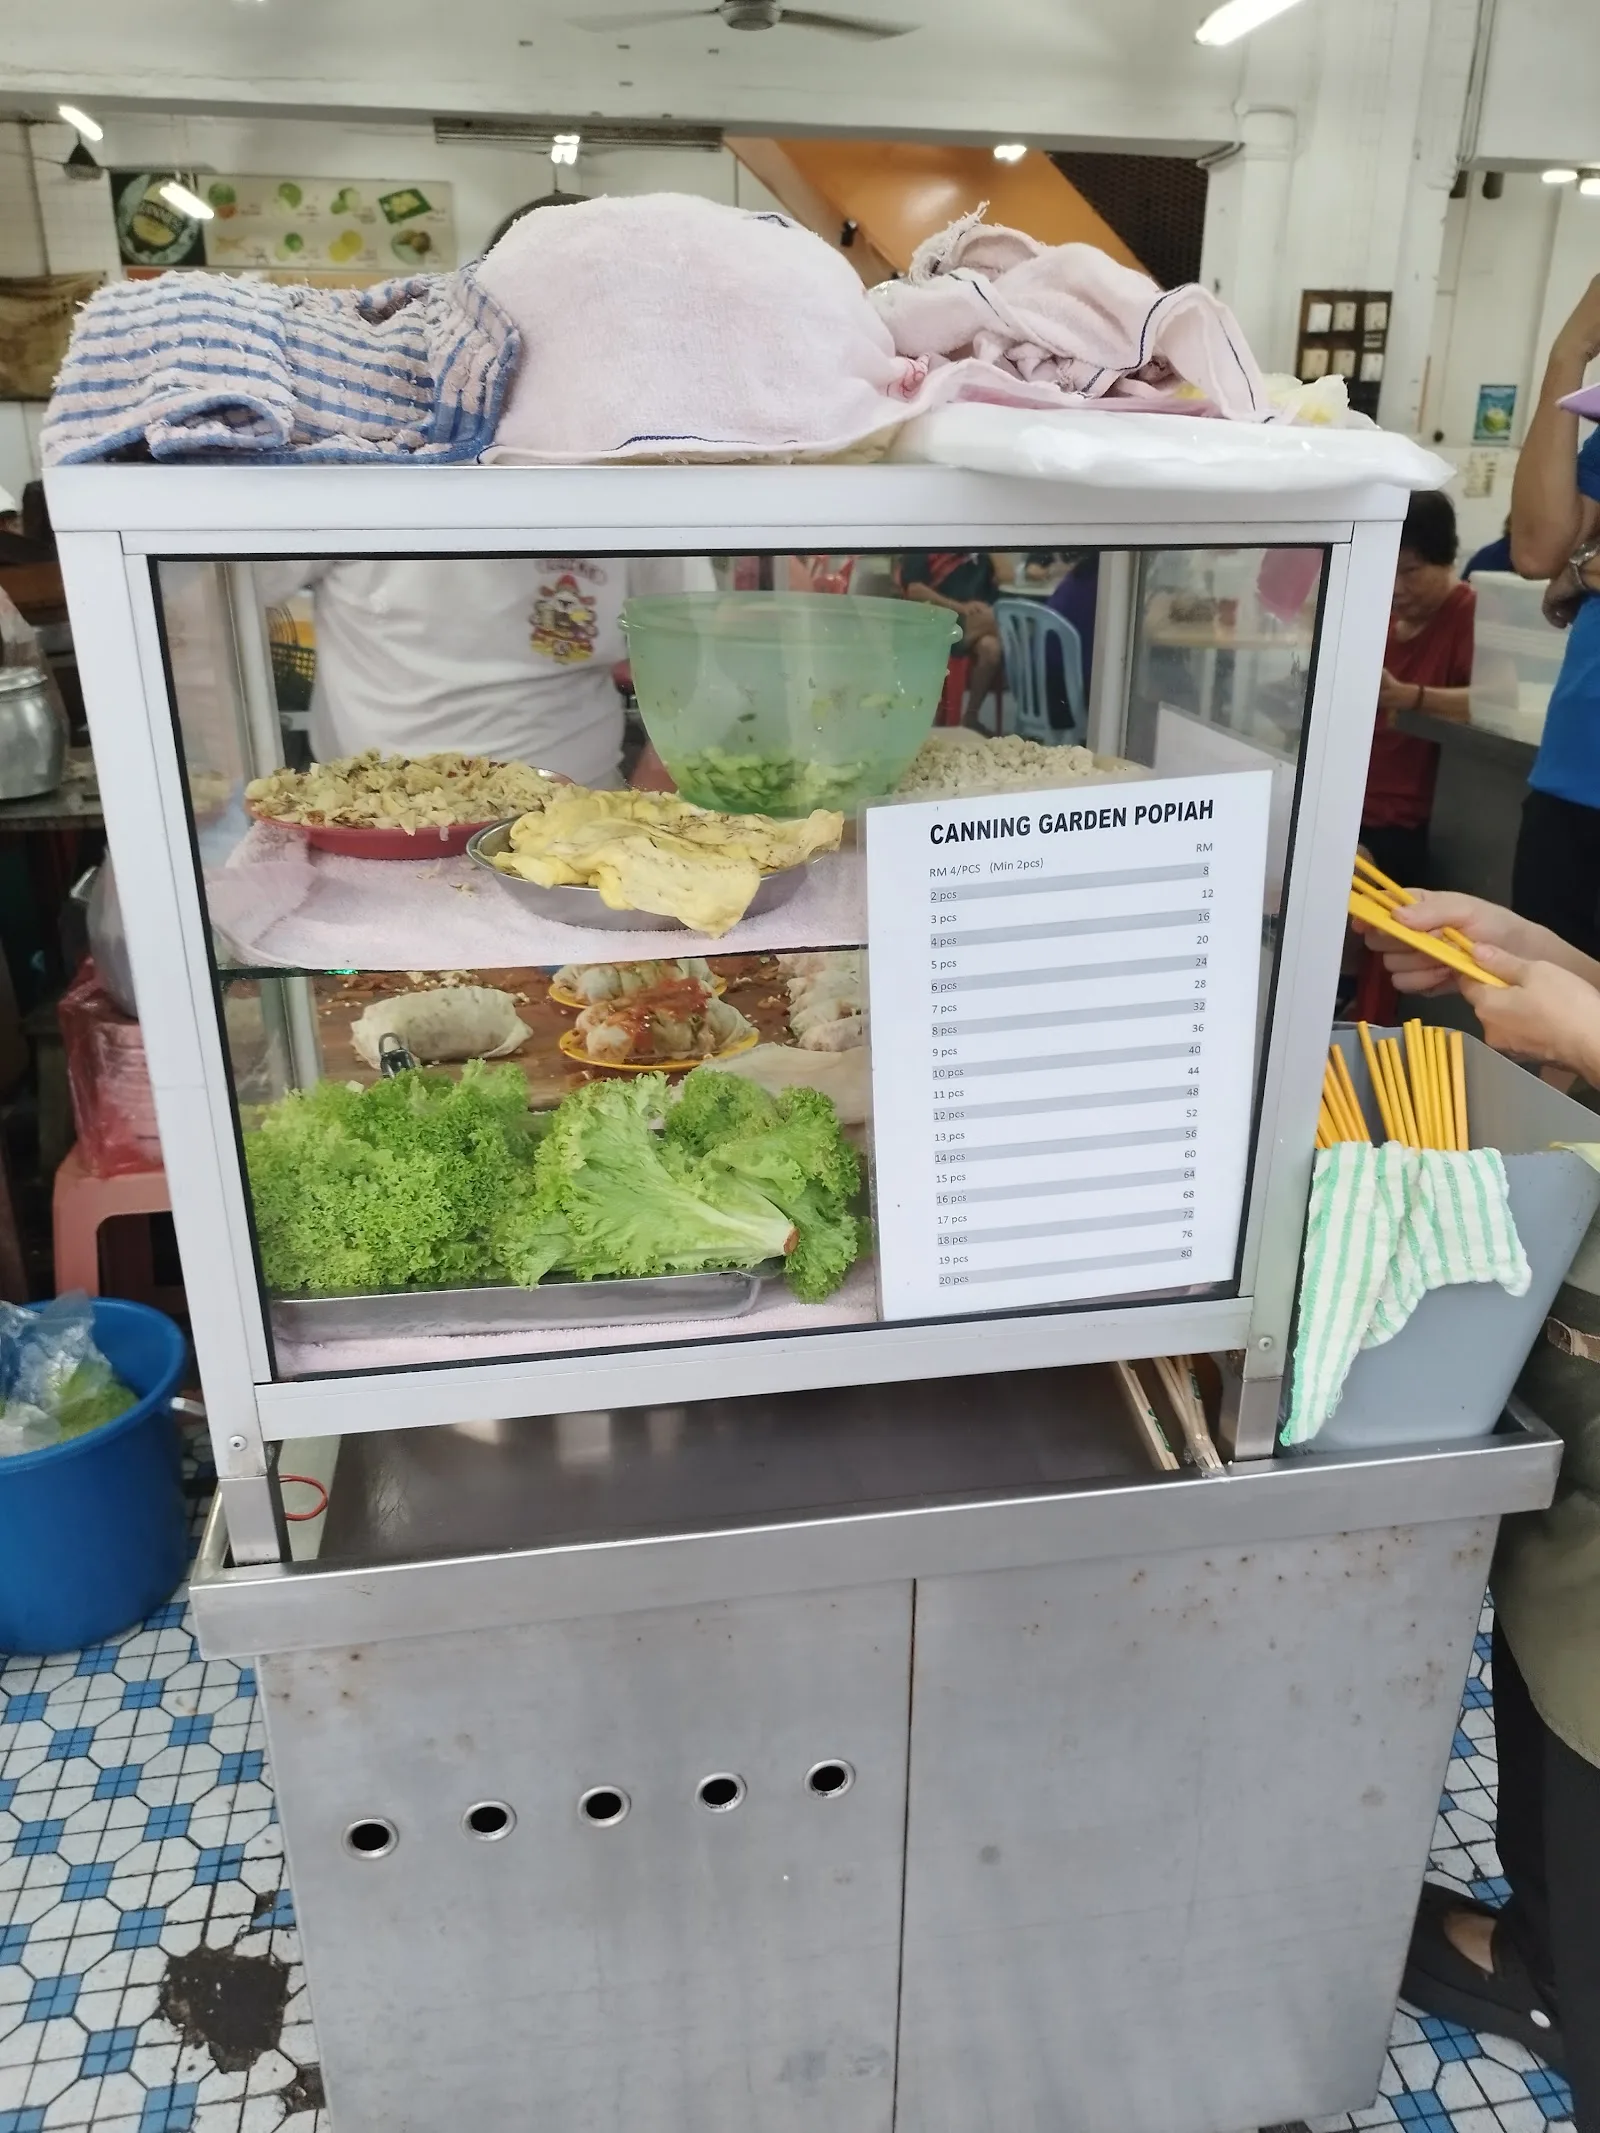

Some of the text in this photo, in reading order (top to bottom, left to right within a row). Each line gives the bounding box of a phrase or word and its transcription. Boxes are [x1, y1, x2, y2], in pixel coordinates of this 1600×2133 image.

[930, 800, 1214, 844] CANNING GARDEN POPIAH
[1196, 842, 1213, 852] RM
[929, 857, 1044, 877] RM 4/PCS (Min 2pcs)
[1203, 866, 1209, 876] 8
[931, 891, 957, 901] 2 pcs
[1202, 889, 1214, 898] 12
[931, 914, 957, 925] 3 pcs
[1198, 912, 1210, 922] 16
[931, 937, 957, 947] 4 pcs
[1197, 935, 1208, 944] 20
[931, 960, 957, 970] 5 pcs
[1196, 958, 1207, 967] 24
[931, 982, 957, 992] 6 pcs
[1195, 980, 1206, 989] 28
[932, 1004, 957, 1015] 7 pcs
[1193, 1002, 1205, 1011] 32
[932, 1026, 957, 1037] 8 pcs
[1192, 1023, 1204, 1032] 36
[933, 1048, 958, 1057] 9 pcs
[1189, 1045, 1201, 1054] 40
[933, 1069, 964, 1078] 10 pcs
[1188, 1067, 1200, 1075] 44
[933, 1089, 964, 1099] 11 pcs
[1187, 1088, 1199, 1096] 48
[934, 1111, 964, 1120] 12 pcs
[1186, 1109, 1198, 1117] 52
[935, 1132, 965, 1142] 13 pcs
[1185, 1129, 1197, 1138] 56
[935, 1153, 966, 1163] 14 pcs
[1184, 1150, 1196, 1158] 60
[936, 1174, 967, 1183] 15 pcs
[1183, 1170, 1196, 1179] 64
[1183, 1190, 1195, 1199] 68
[937, 1195, 967, 1204] 16 pcs
[1182, 1210, 1195, 1219] 72
[938, 1215, 968, 1224] 17 pcs
[1181, 1229, 1194, 1238] 76
[938, 1235, 969, 1245] 18 pcs
[1180, 1249, 1193, 1258] 80
[939, 1255, 970, 1265] 19 pcs
[939, 1275, 970, 1285] 20 pcs
